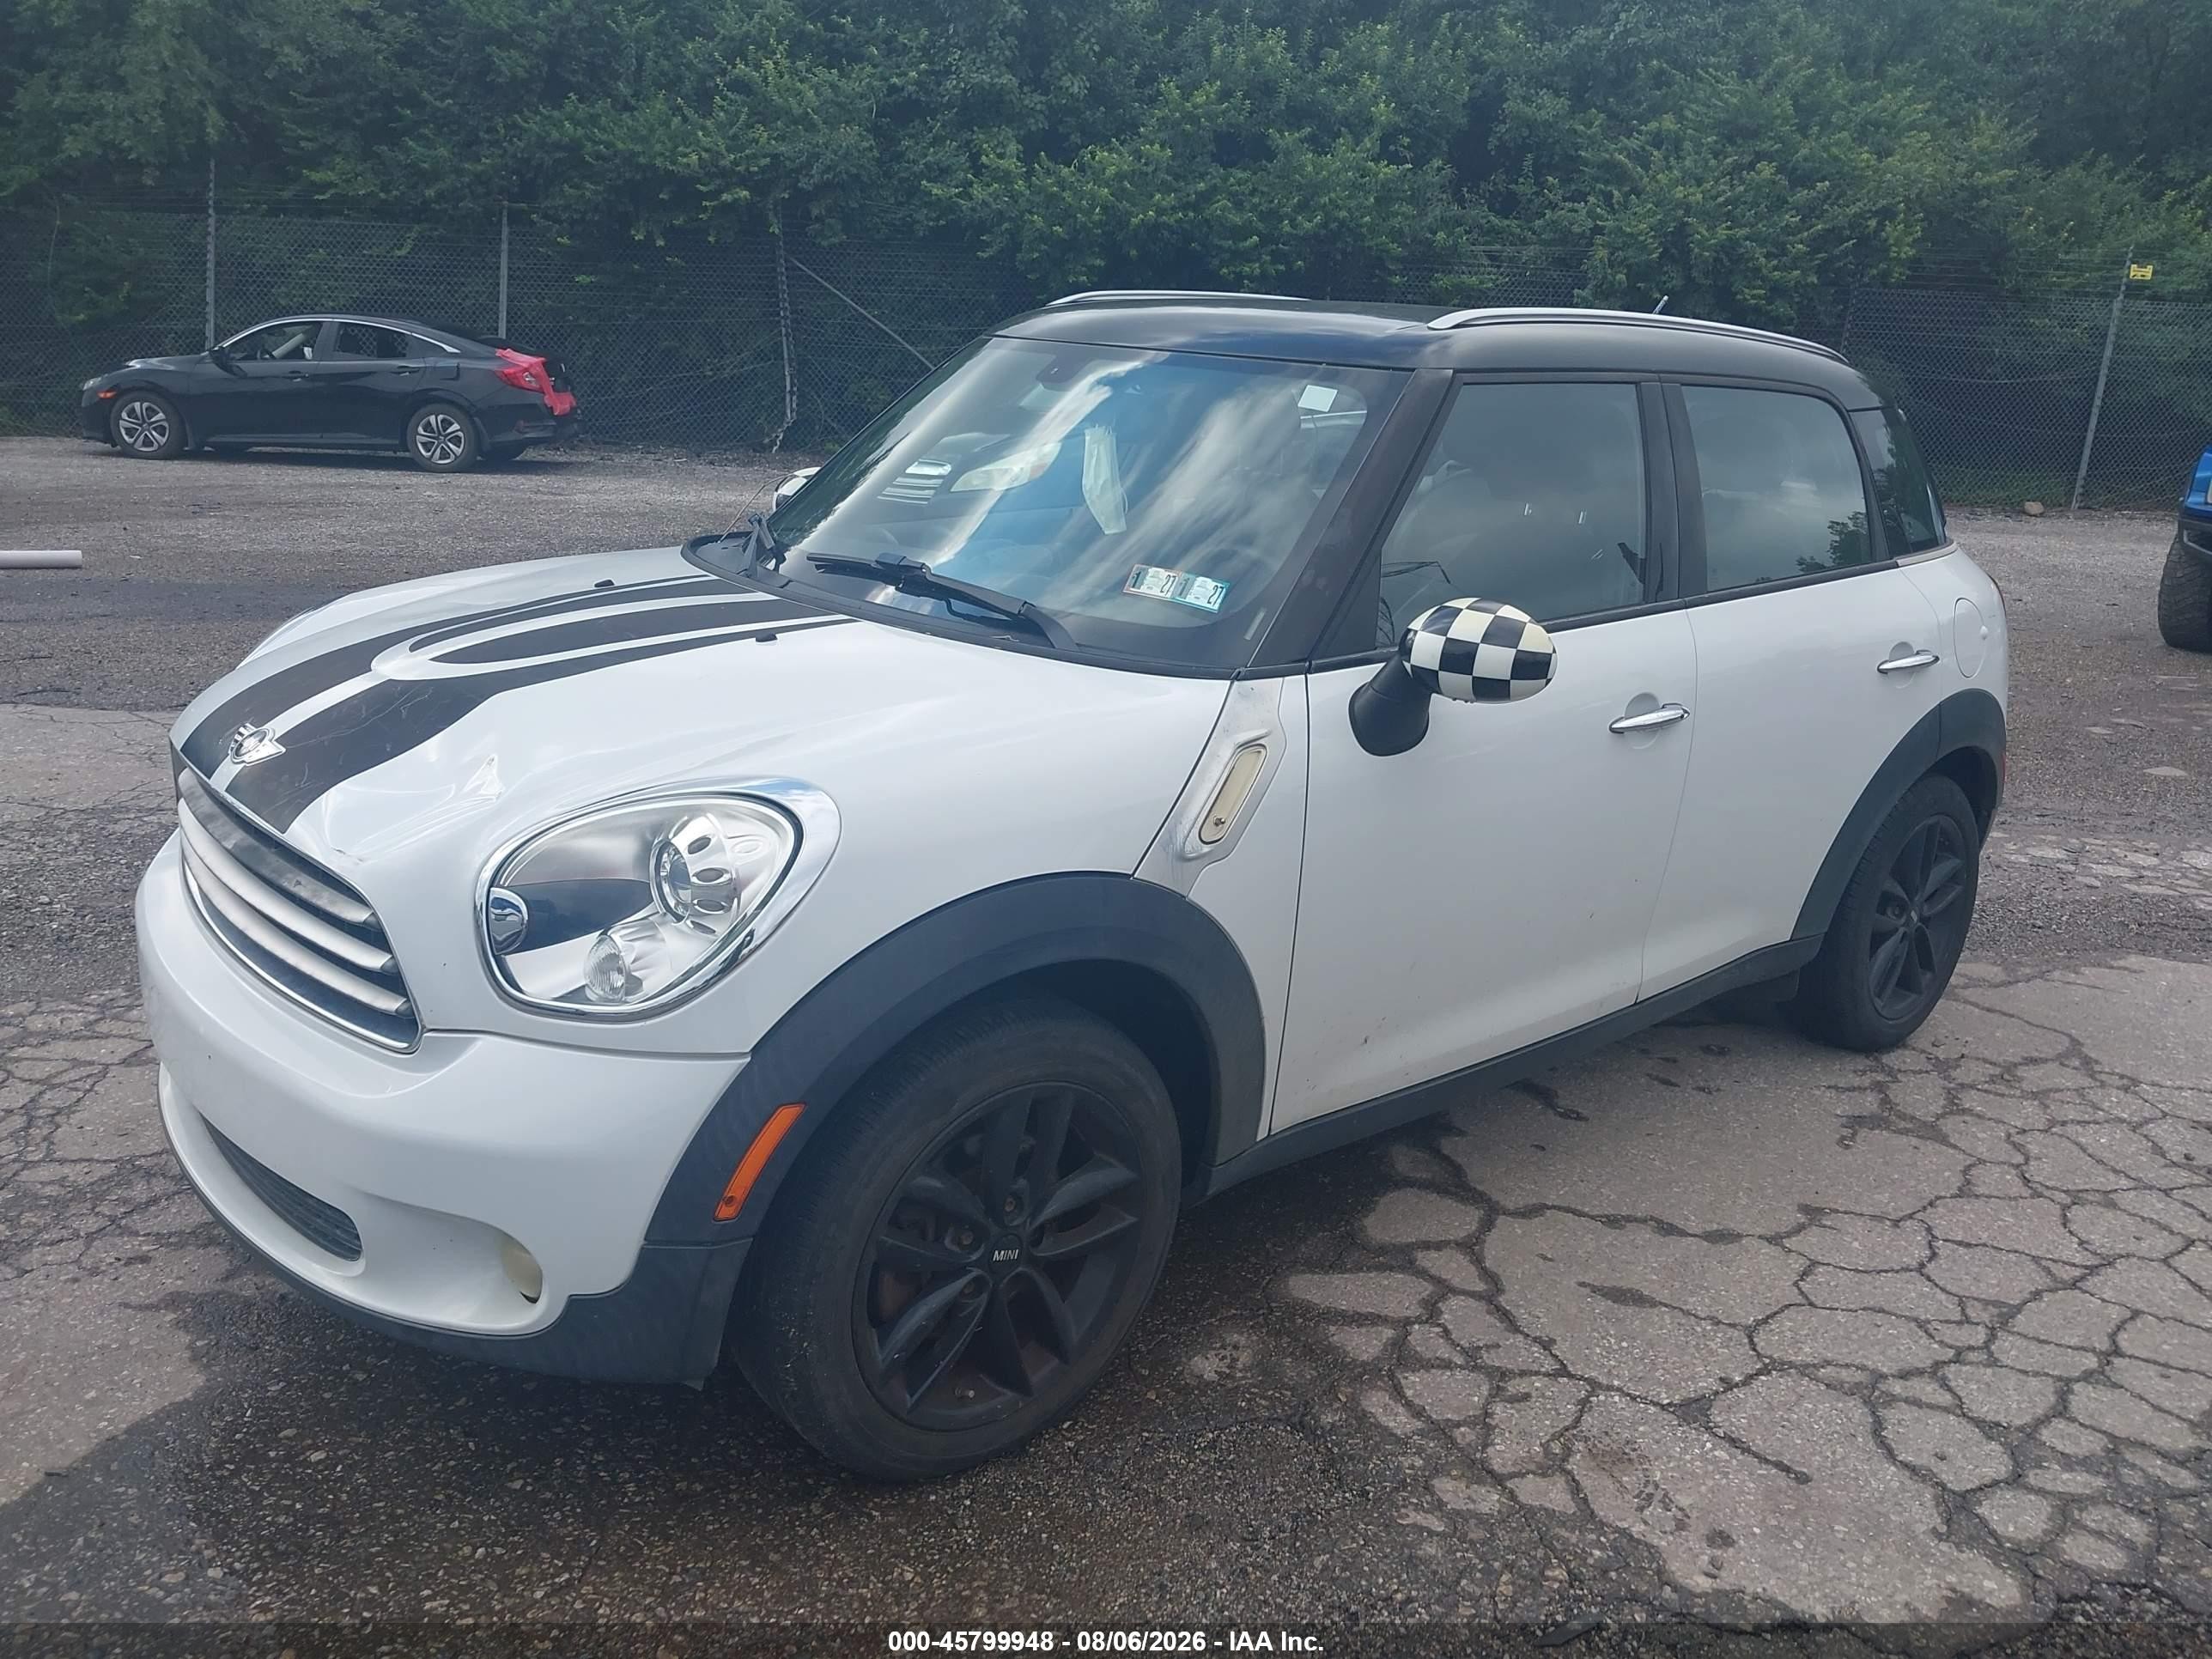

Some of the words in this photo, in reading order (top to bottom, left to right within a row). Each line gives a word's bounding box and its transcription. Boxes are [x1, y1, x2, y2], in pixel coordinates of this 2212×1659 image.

[1159, 574, 1177, 596] 27
[1206, 585, 1224, 606] 27
[993, 1249, 1019, 1261] MINI
